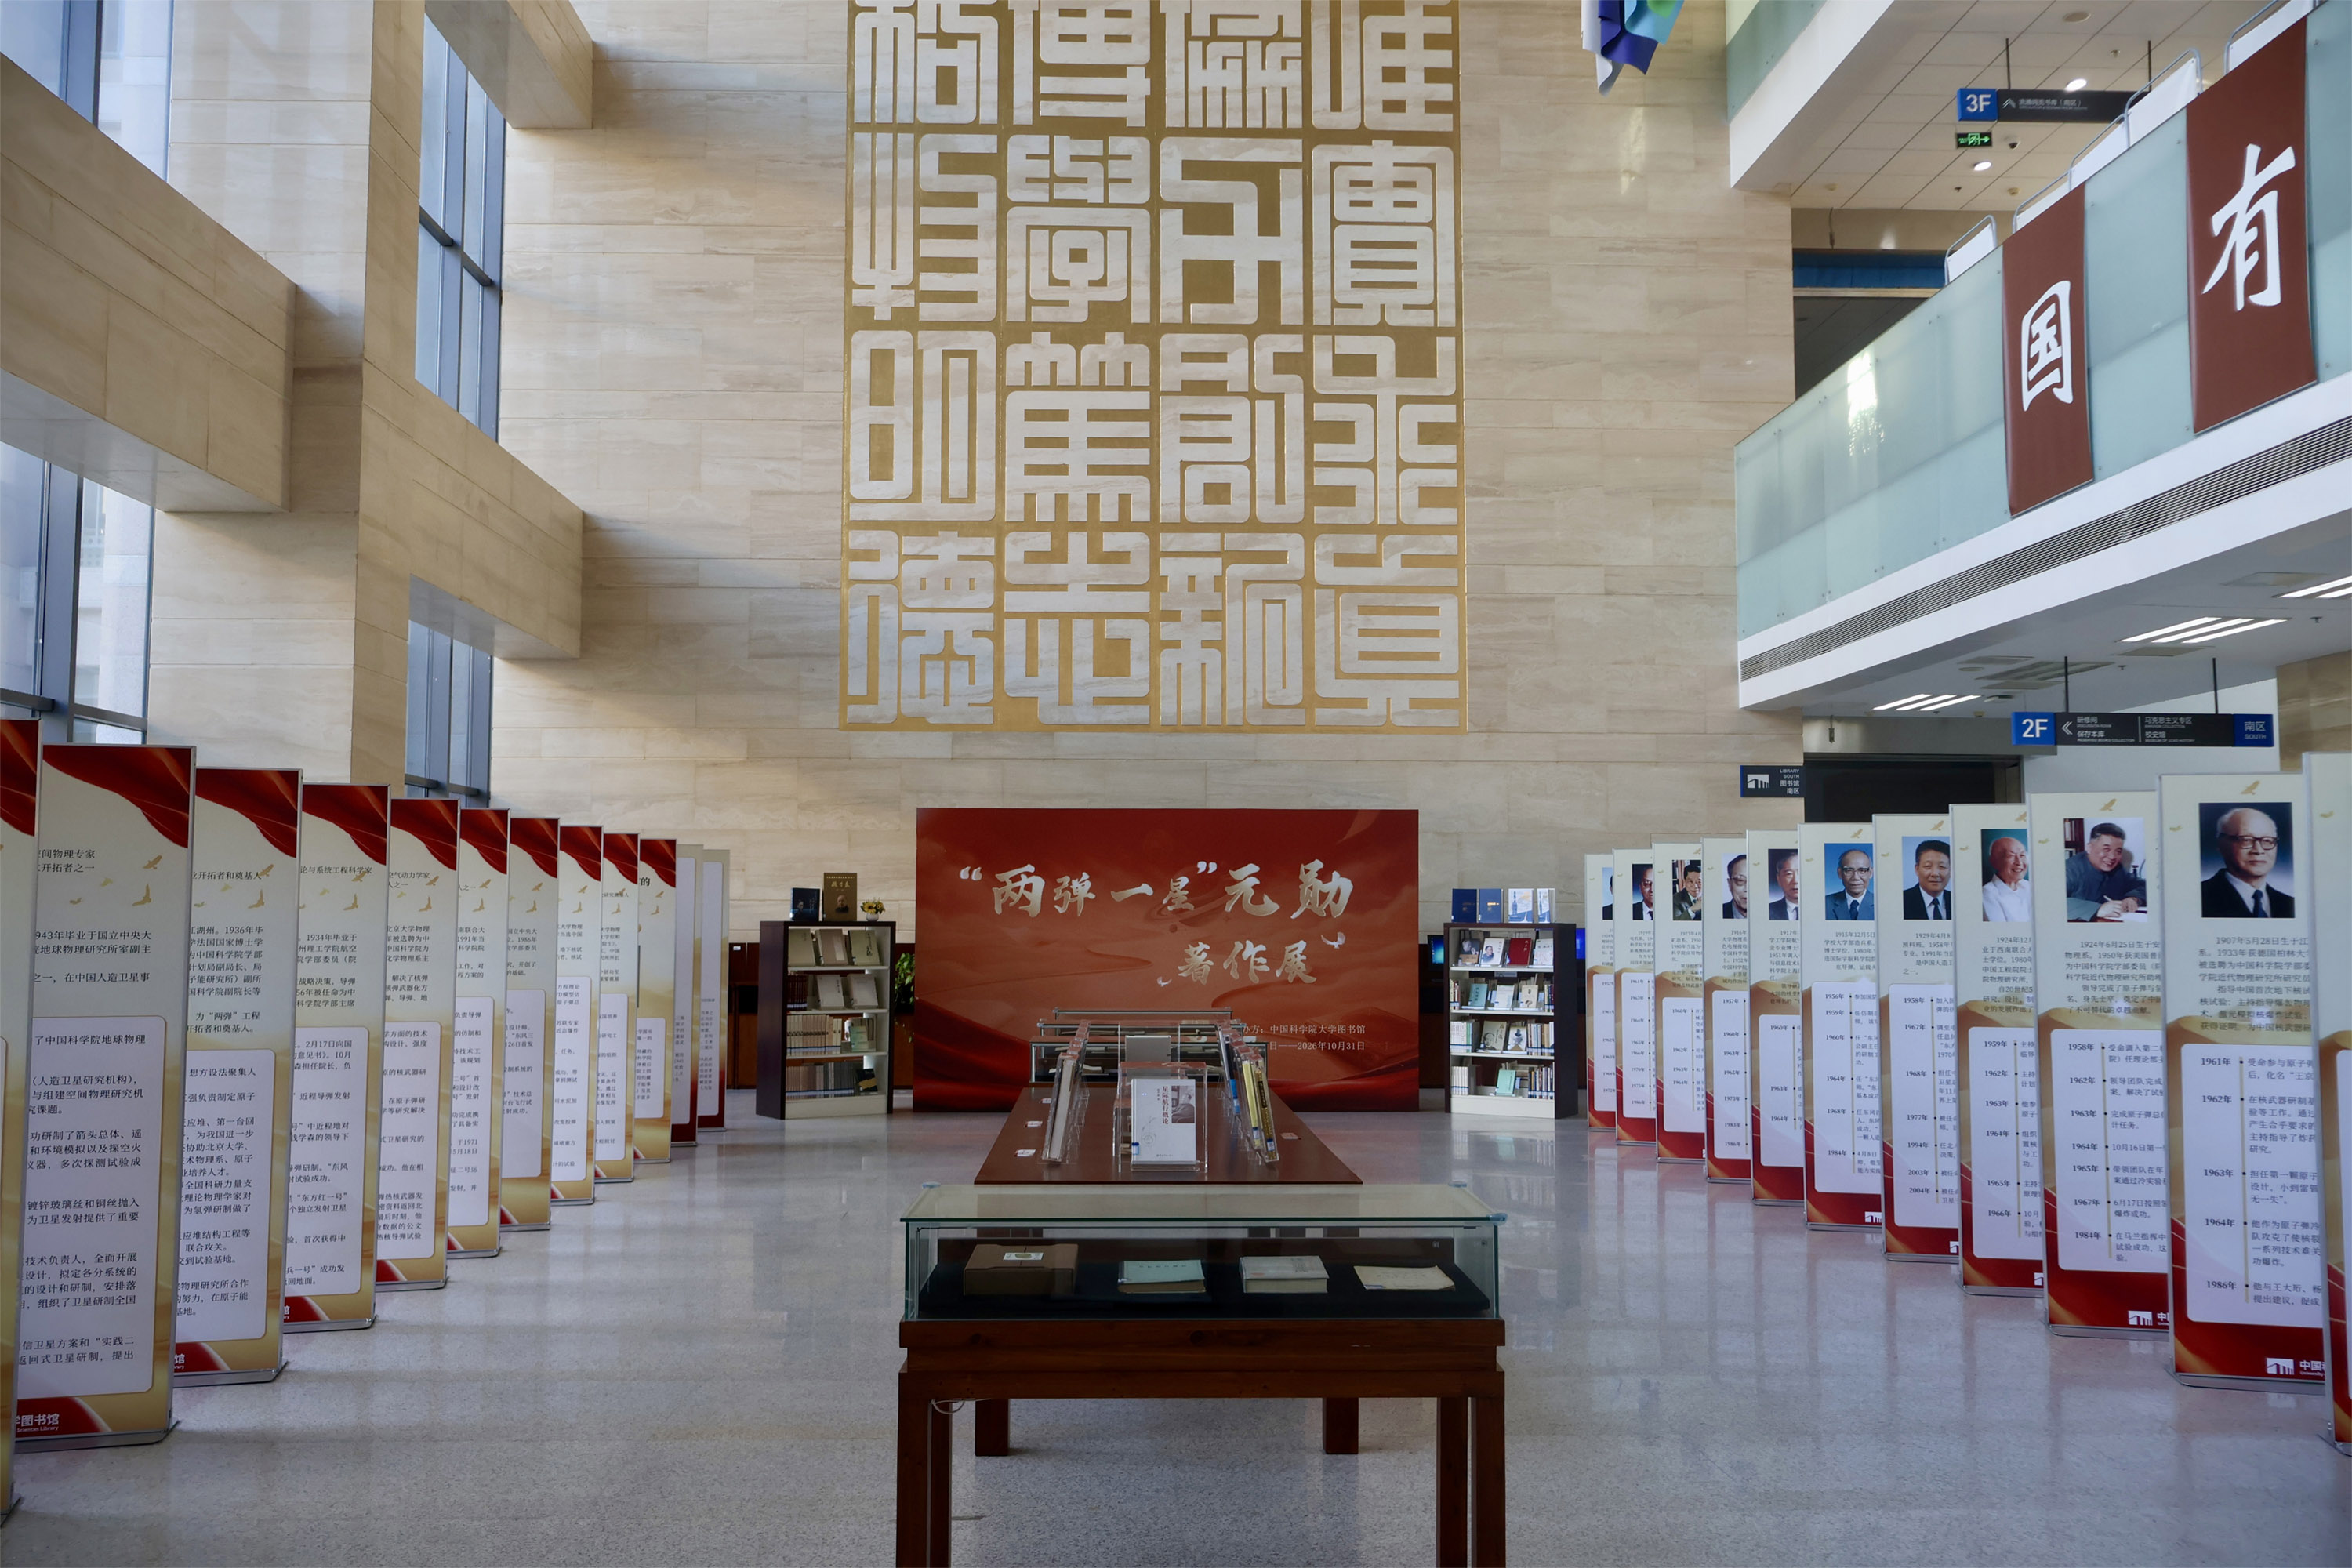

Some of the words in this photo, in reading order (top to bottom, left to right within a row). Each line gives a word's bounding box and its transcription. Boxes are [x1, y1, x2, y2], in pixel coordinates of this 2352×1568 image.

[1966, 94, 1991, 112] 3F
[2201, 143, 2296, 311] 有
[2021, 280, 2073, 412] 国
[2022, 718, 2049, 738] 2F
[2244, 721, 2267, 731] 南区
[38, 849, 96, 859] 间物理专家
[38, 863, 95, 873] 开拓者之一
[2198, 949, 2310, 957] 系。1933年获德国柏林大
[1178, 939, 1317, 985] 著作展
[34, 1035, 147, 1046] 了中国科学院地球物理
[189, 1068, 256, 1077] 想方设法聚集人
[32, 1089, 143, 1100] 与组建空间物理研究机
[184, 1117, 255, 1127] 应堆、第一台回
[30, 1143, 142, 1155] 和环境模拟以及探空火
[183, 1142, 249, 1152] 协助北京大学、
[183, 1154, 253, 1165] 术物理系、原子
[182, 1179, 252, 1189] 全国科研力量支
[181, 1192, 252, 1203] 理论物理学家对
[27, 1197, 140, 1210] 镀锌玻璃丝和铜丝抛入
[27, 1211, 140, 1225] 为卫星发射提供了重要
[2205, 1218, 2235, 1227] 1964年
[22, 1252, 138, 1266] 技术负责人，全面开展
[21, 1266, 137, 1280] 设计，拟定各分系统的
[21, 1281, 136, 1295] 的设计和研制，安排落
[178, 1279, 249, 1290] 物理研究所合作
[2206, 1280, 2237, 1289] 1986年
[20, 1336, 134, 1351] 信卫星方案和“实践二
